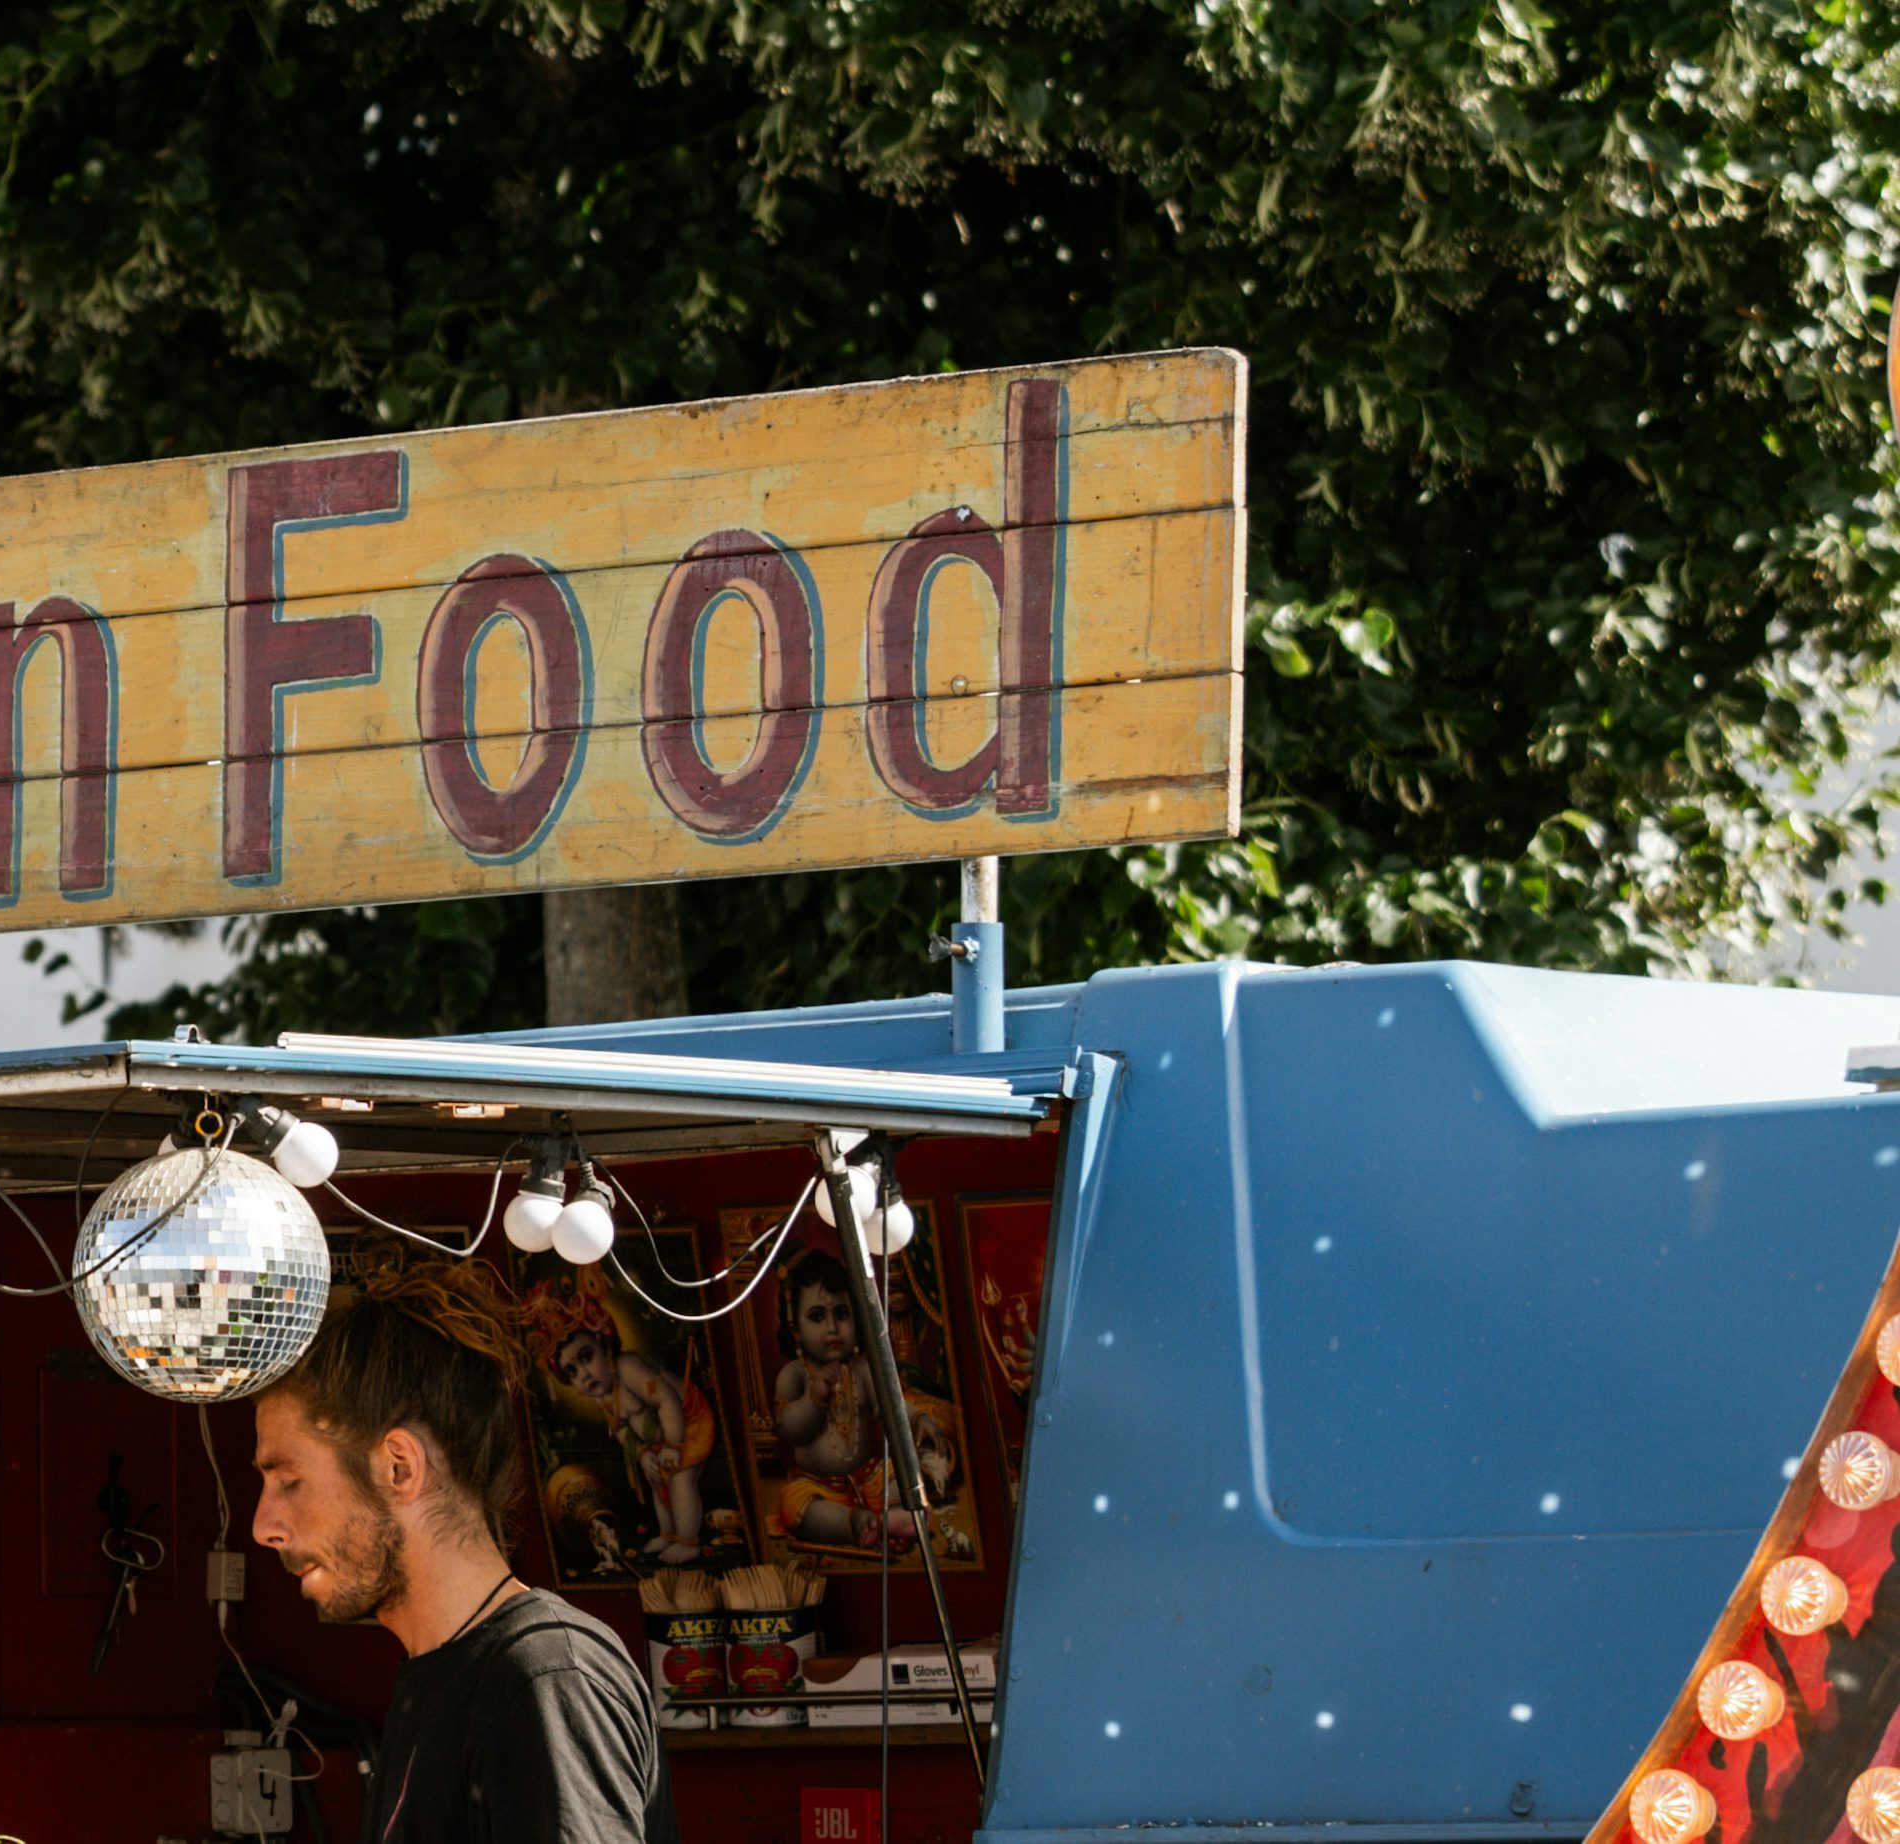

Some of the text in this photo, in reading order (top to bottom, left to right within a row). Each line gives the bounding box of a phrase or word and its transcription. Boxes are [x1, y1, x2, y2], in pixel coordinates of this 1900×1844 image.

[220, 375, 1072, 887] Food
[729, 1616, 792, 1635] AKFA
[913, 1664, 948, 1677] Gloves
[813, 1807, 857, 1841] JBL
